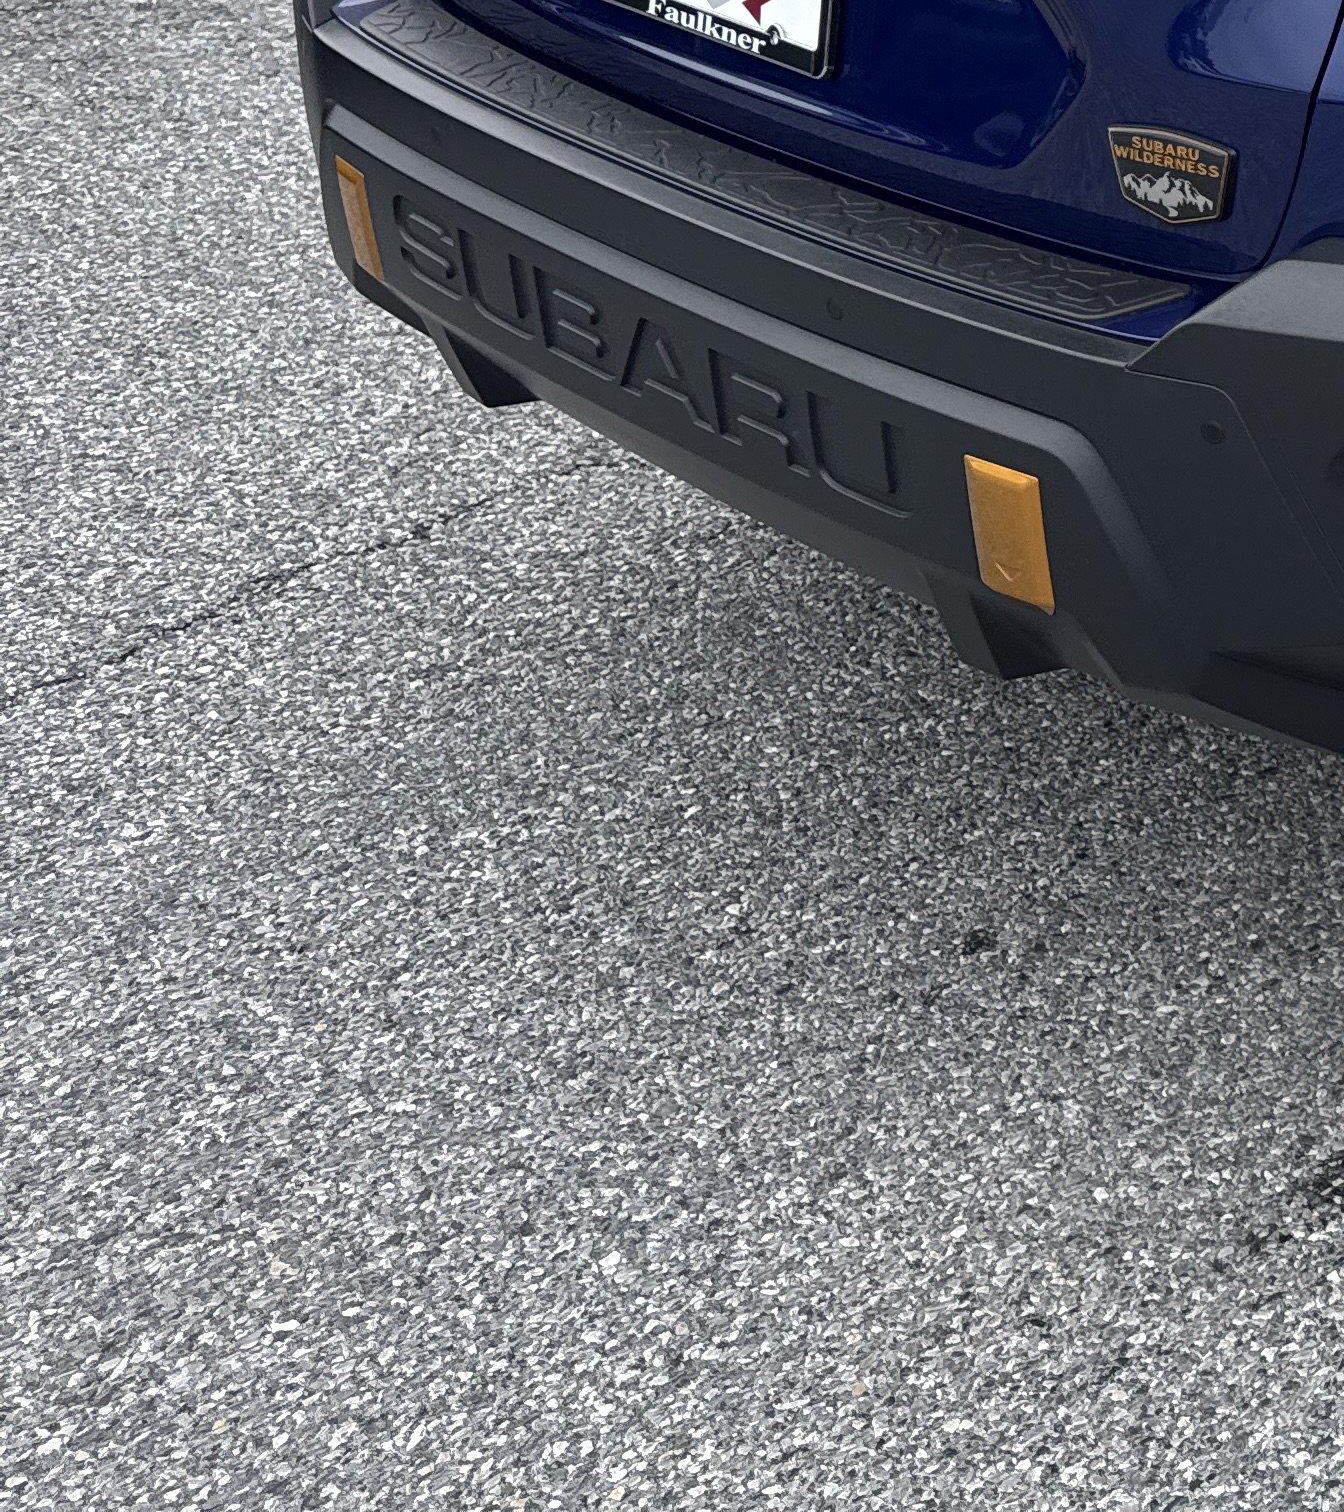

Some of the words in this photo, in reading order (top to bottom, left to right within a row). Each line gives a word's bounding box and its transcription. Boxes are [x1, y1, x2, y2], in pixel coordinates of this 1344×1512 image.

[1113, 144, 1220, 178] WILDERNESS
[1131, 136, 1200, 161] SUBARU
[393, 194, 913, 519] SUBARU
